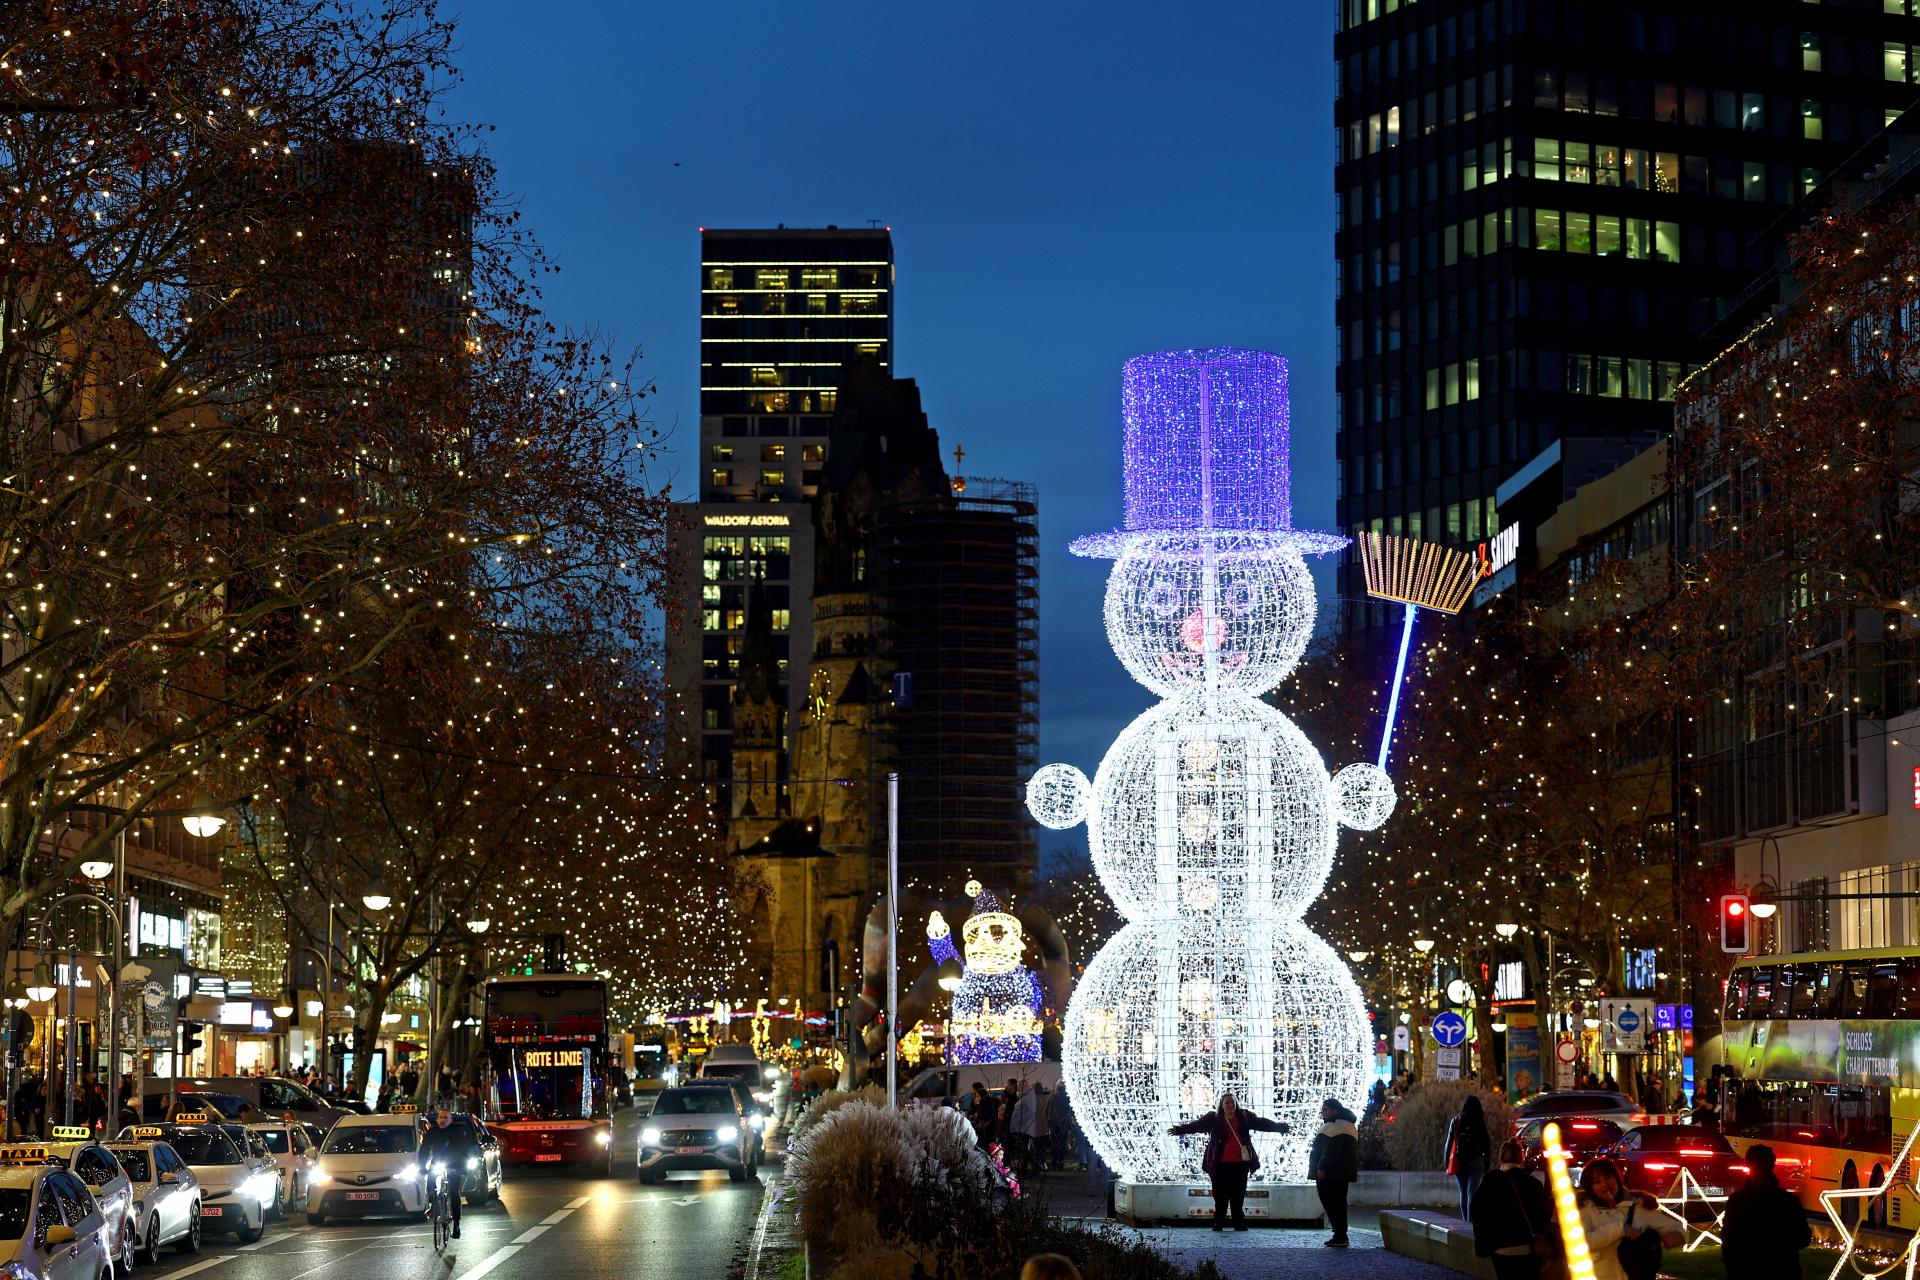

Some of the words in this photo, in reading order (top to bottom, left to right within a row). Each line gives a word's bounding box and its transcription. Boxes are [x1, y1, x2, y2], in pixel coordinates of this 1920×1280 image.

[704, 516, 750, 526] WALDORF
[751, 516, 790, 526] ASTORIA
[1491, 520, 1519, 574] SATURN
[1846, 1032, 1873, 1050] SCHLOSS
[526, 1051, 552, 1067] ROTE
[554, 1050, 583, 1067] LINIE
[1845, 1056, 1899, 1076] CHARLOTTENBURG
[58, 1128, 82, 1136] TAXI
[7, 1149, 39, 1158] TAXI
